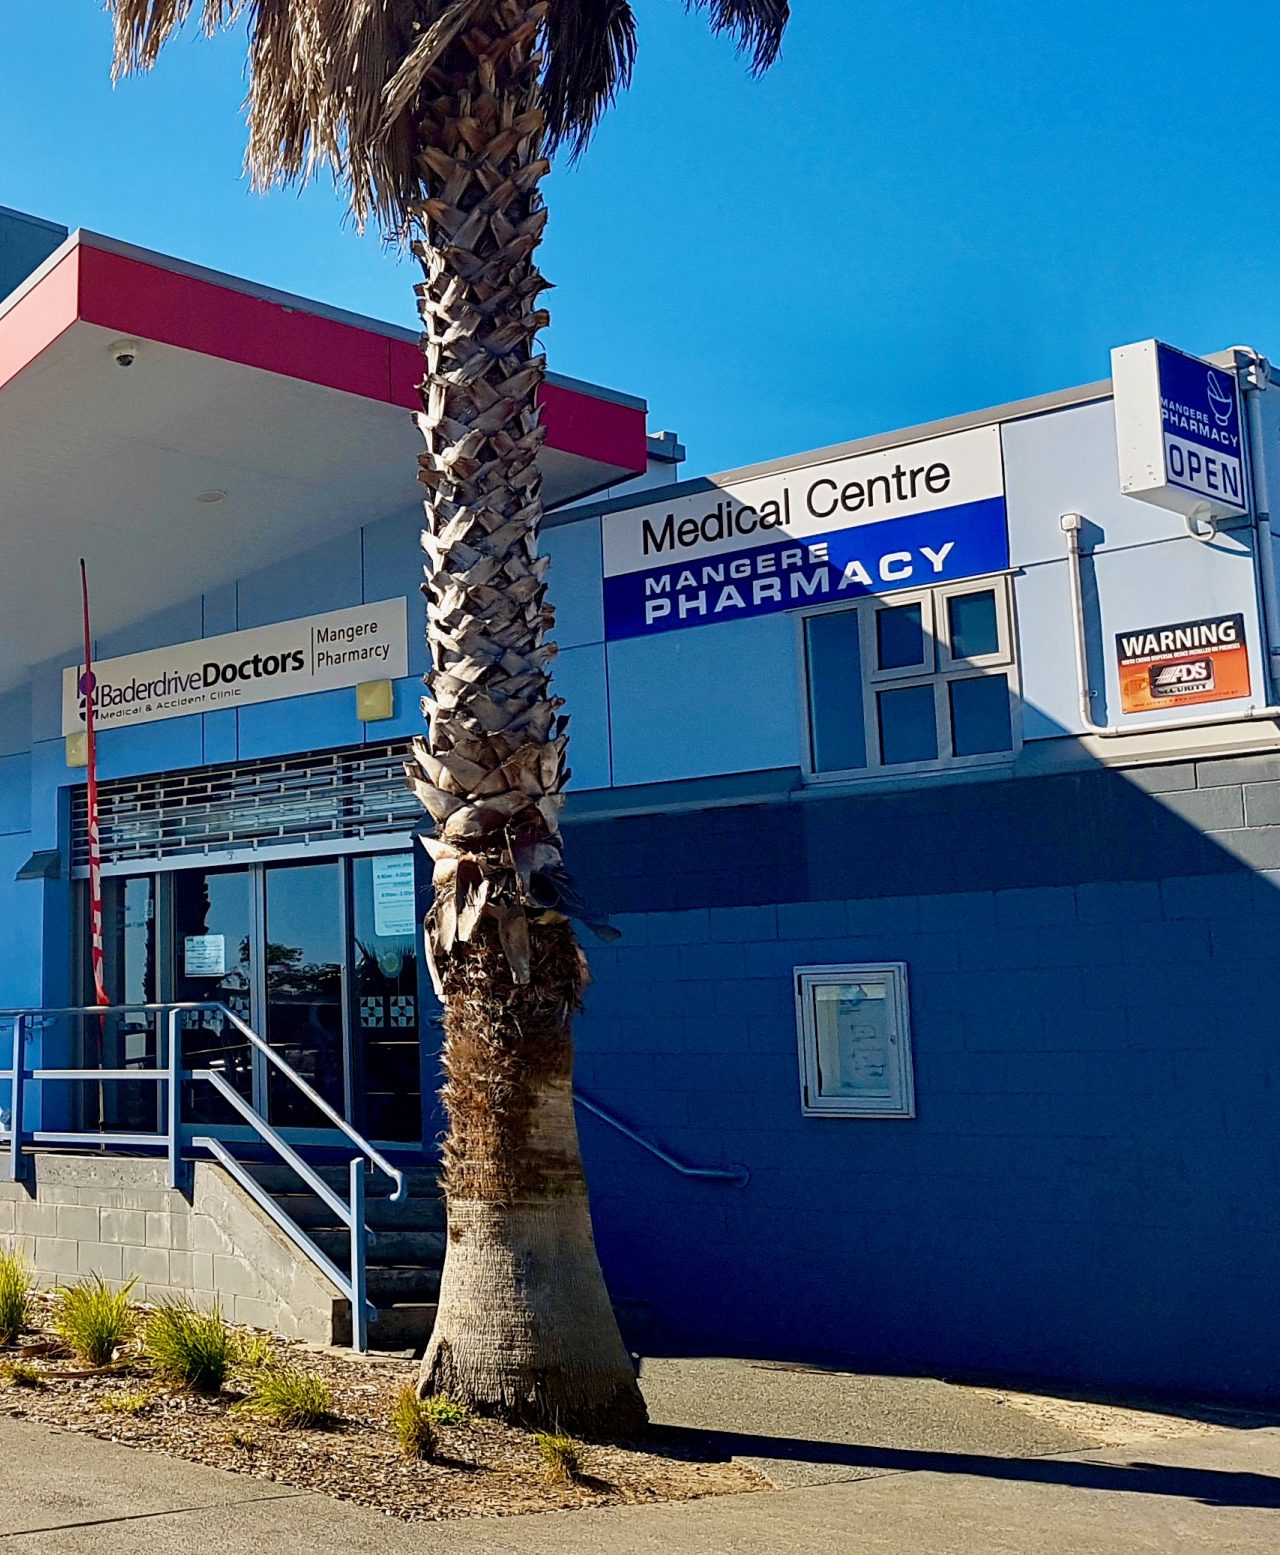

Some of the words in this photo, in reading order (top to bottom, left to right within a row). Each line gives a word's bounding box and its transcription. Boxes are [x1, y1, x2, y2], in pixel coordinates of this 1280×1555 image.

[1160, 396, 1209, 424] MANGERE
[1161, 409, 1239, 448] PHARMACY
[1169, 443, 1240, 498] OPEN
[642, 488, 791, 556] Medical
[806, 461, 951, 519] Centre
[645, 542, 830, 596] MANGERE
[645, 541, 956, 625] PHARMACY
[316, 621, 378, 644] Mangere
[1121, 621, 1237, 657] WARNING
[317, 643, 390, 668] Pharmarcy
[100, 648, 304, 708] BaderdriveDoctors
[100, 705, 142, 721] Medical
[145, 703, 153, 712] &
[156, 694, 206, 710] Accident
[210, 688, 242, 701] Clinic
